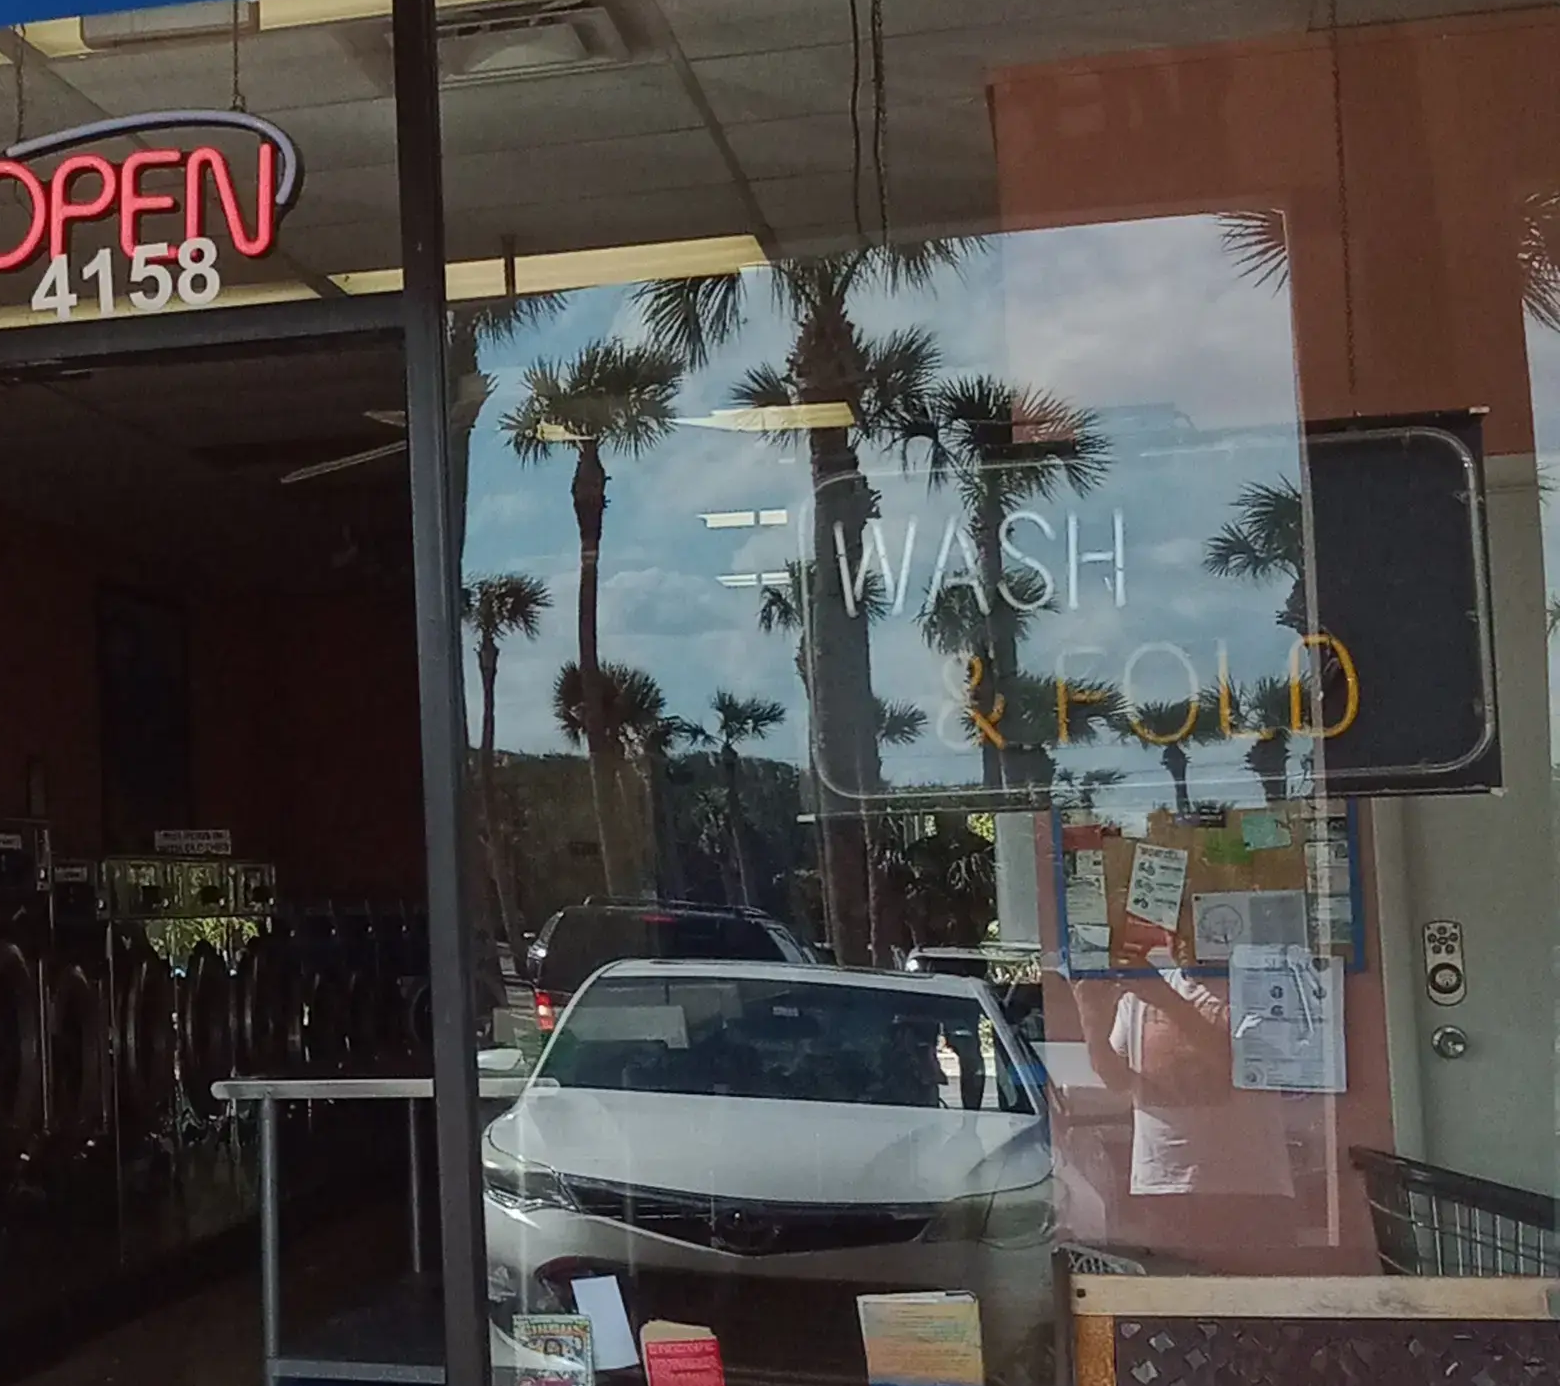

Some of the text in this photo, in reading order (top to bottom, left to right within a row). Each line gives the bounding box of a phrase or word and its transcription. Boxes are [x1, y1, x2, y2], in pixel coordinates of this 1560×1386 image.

[31, 236, 221, 320] 4158
[833, 507, 1126, 617] WASH
[1056, 633, 1361, 747] FOLD
